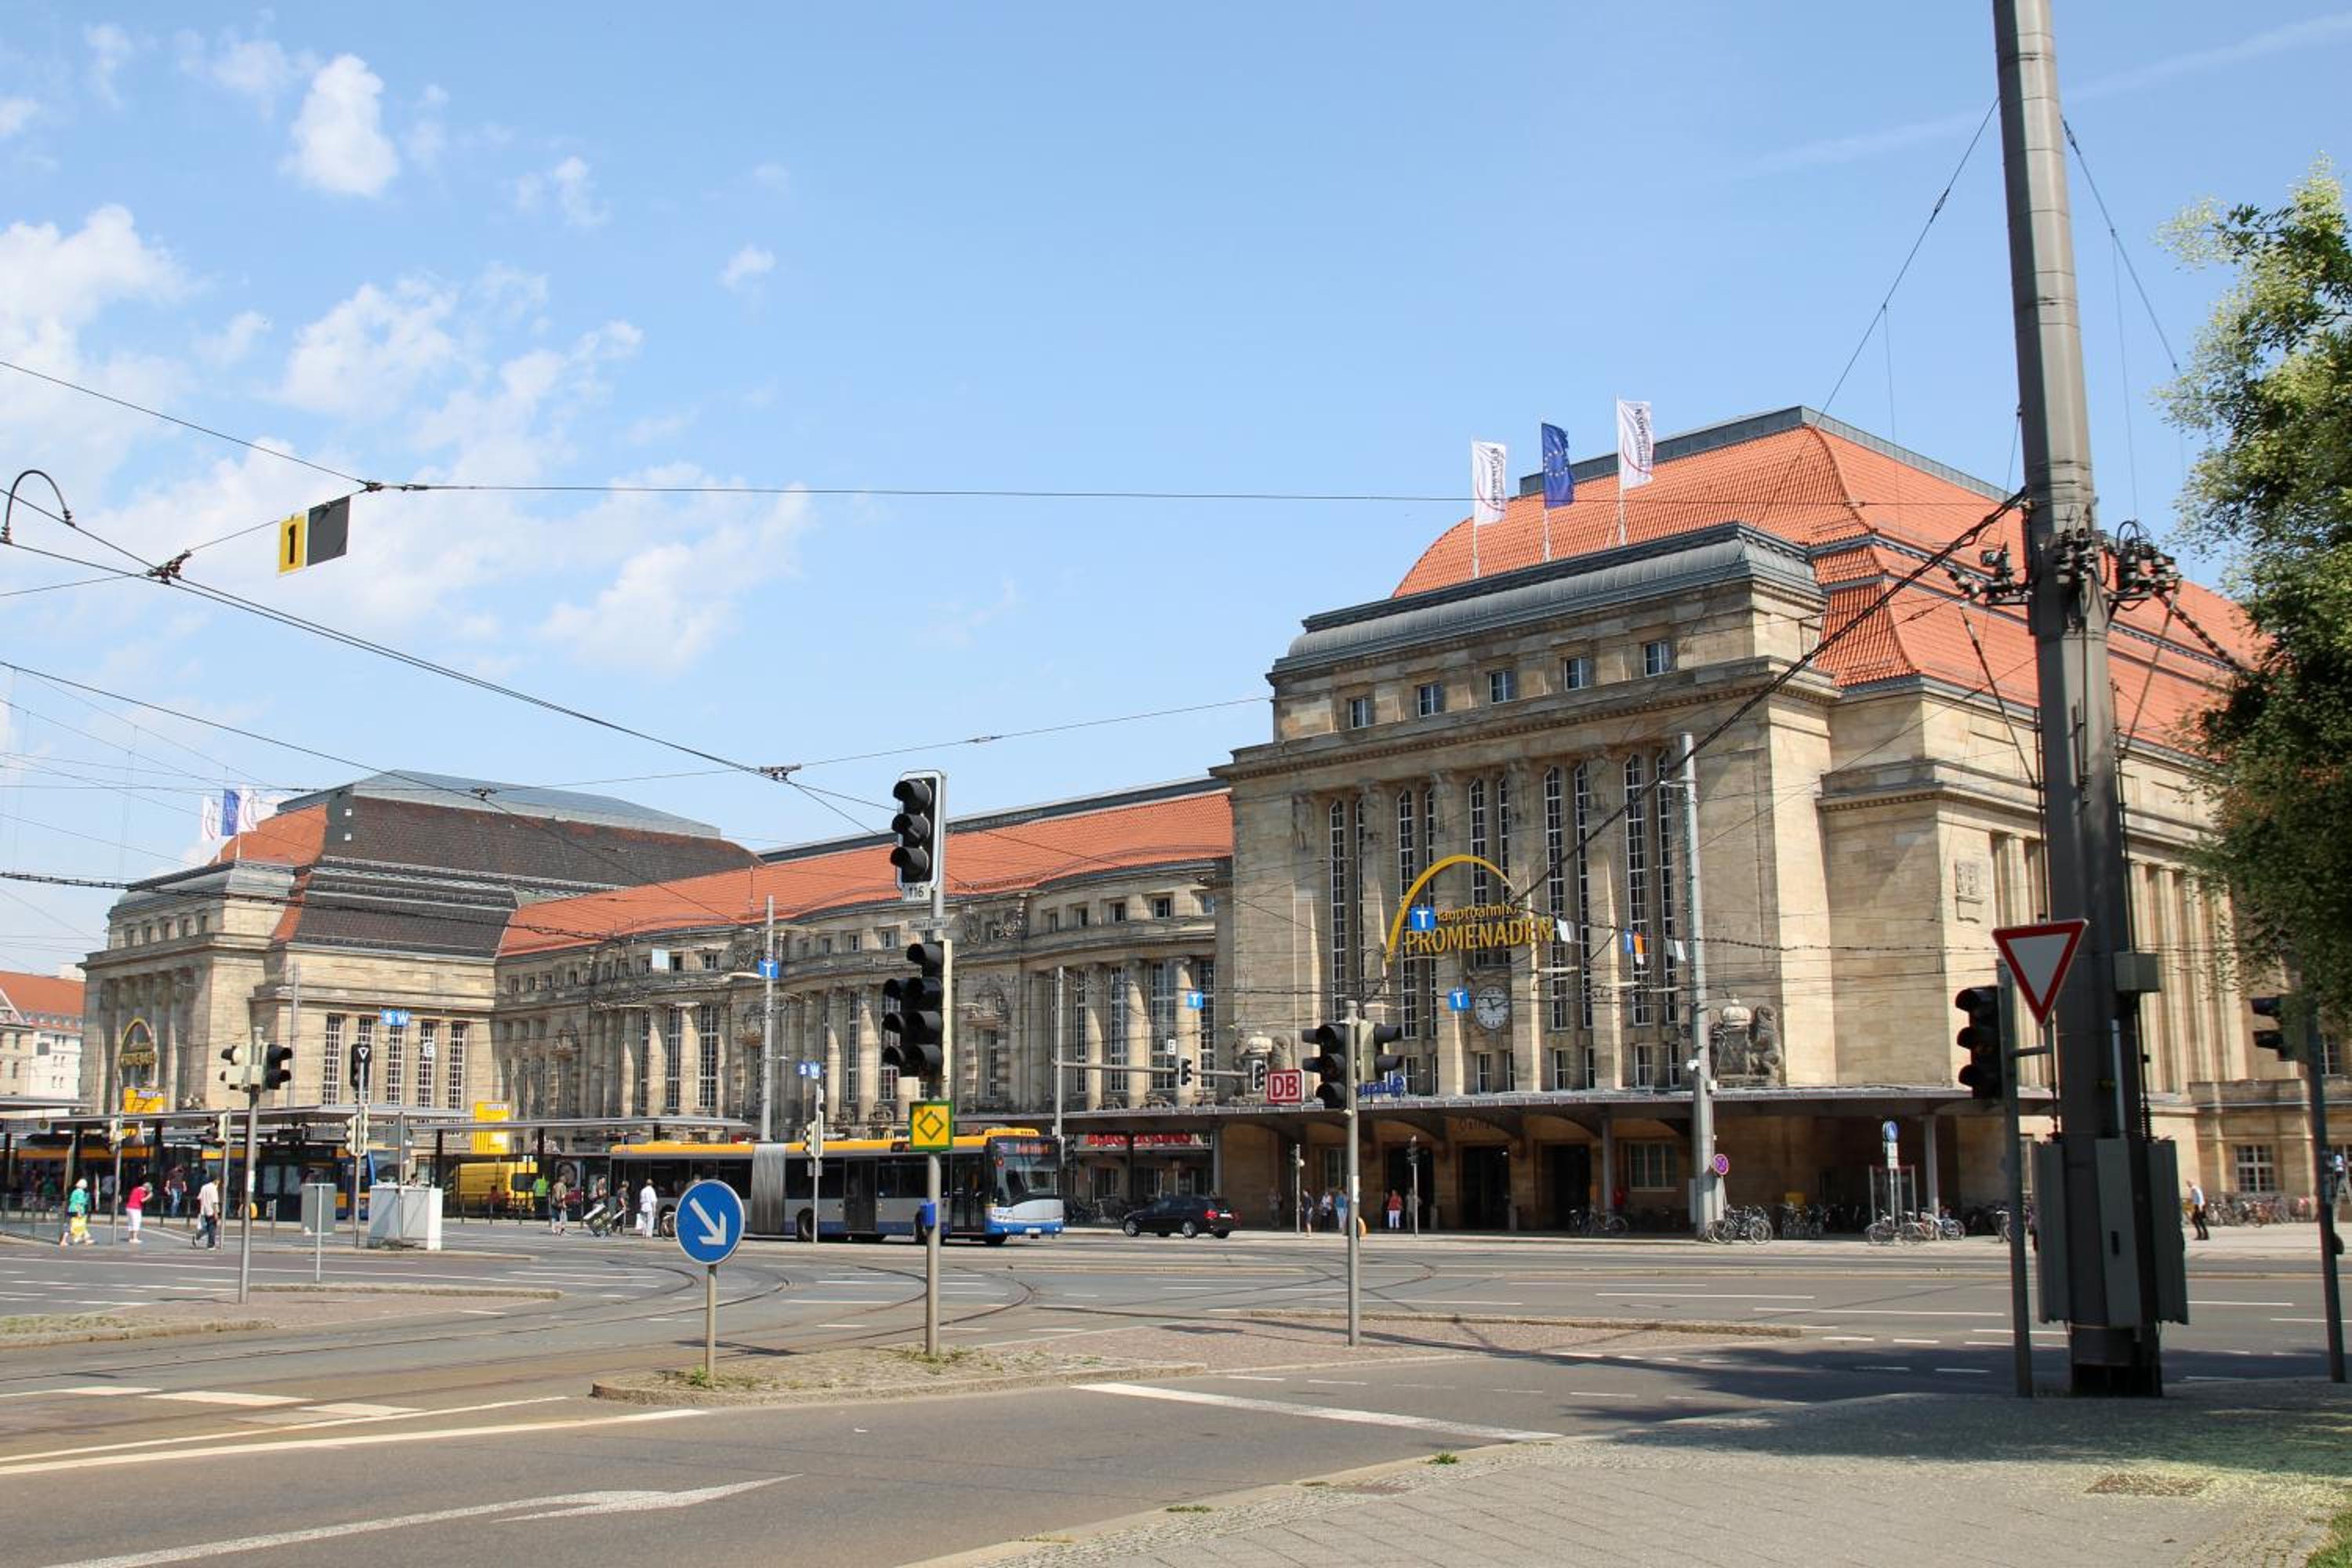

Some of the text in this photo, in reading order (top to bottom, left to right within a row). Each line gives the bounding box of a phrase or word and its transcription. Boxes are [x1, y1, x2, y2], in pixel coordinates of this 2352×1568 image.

[288, 524, 296, 564] 1
[1416, 910, 1429, 928] T
[1404, 916, 1555, 954] PROMENADEN
[1191, 993, 1200, 1006] T
[1453, 992, 1465, 1007] T
[1272, 1075, 1298, 1098] DB
